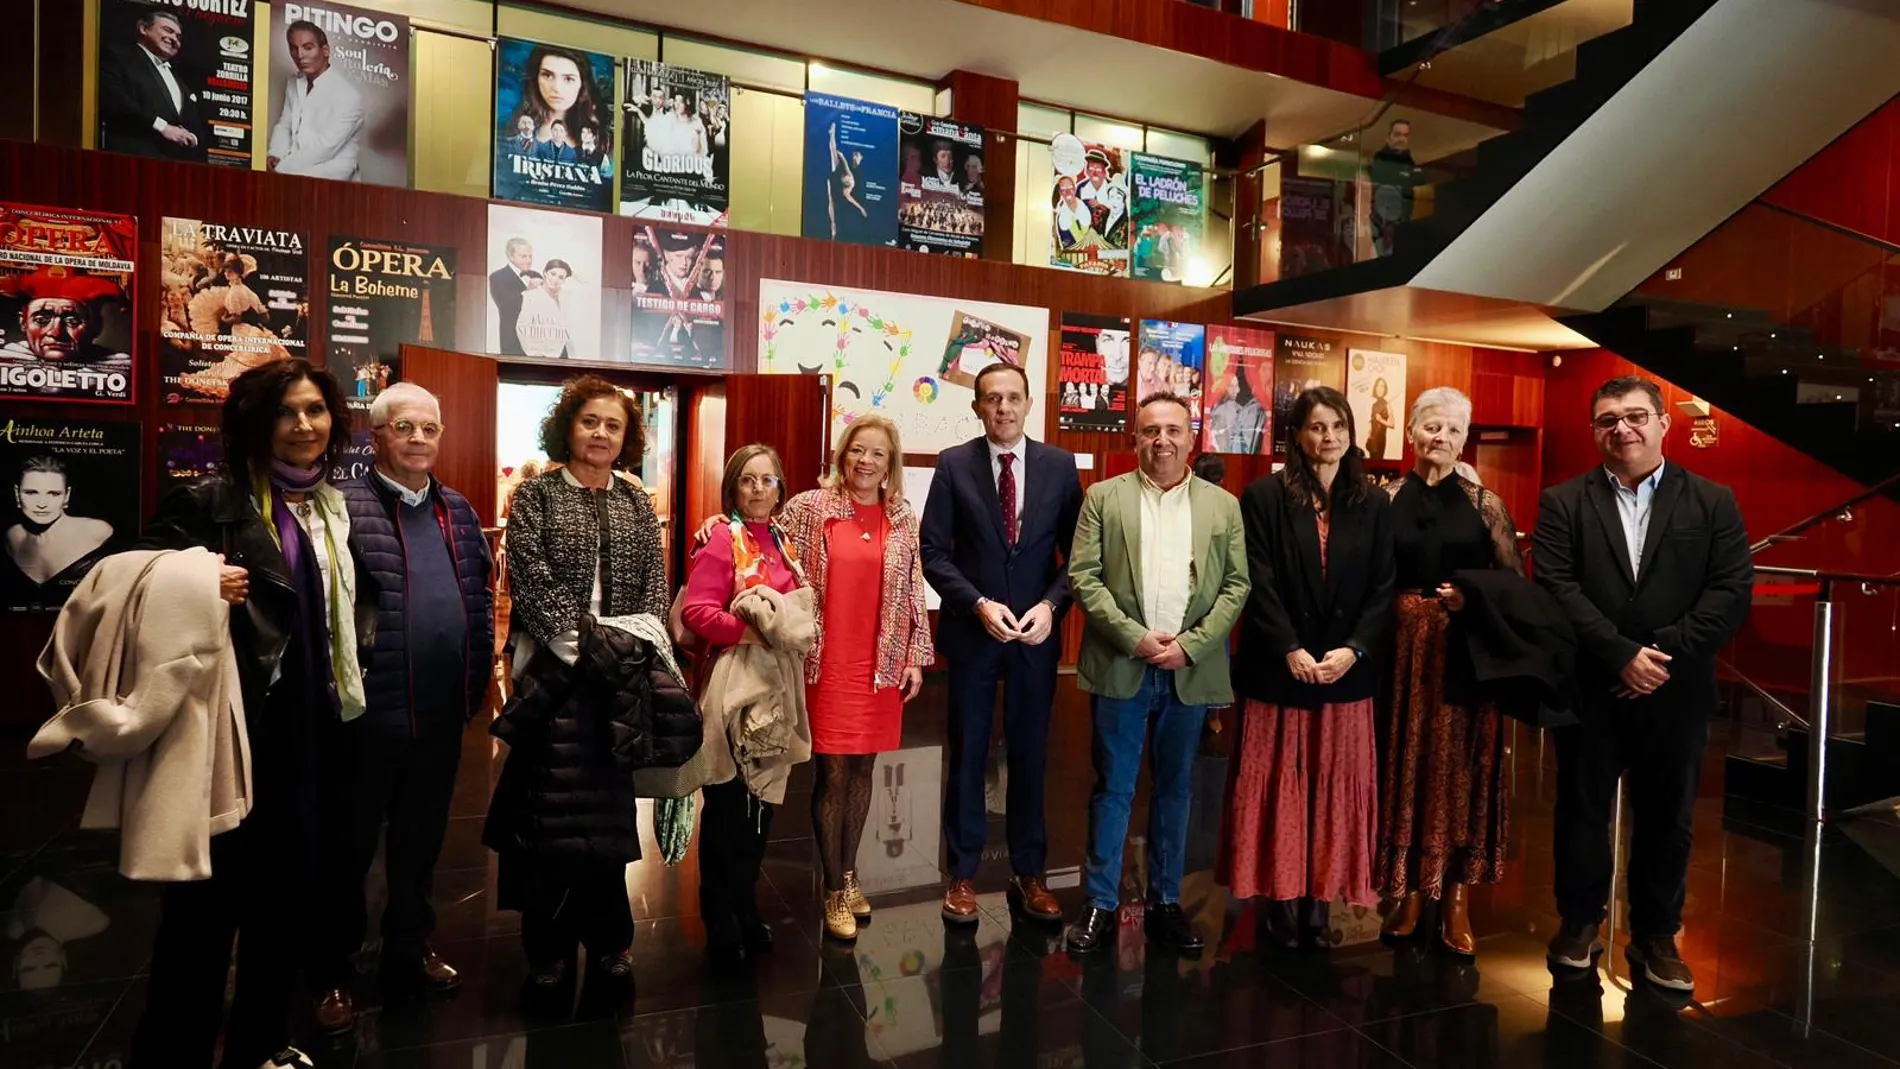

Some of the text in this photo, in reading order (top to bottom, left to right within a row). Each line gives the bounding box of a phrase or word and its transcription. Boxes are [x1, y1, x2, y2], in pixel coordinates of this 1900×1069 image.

[285, 3, 399, 43] PITINGO
[216, 69, 248, 82] ZORRILLA
[223, 62, 248, 74] TEATRO
[508, 153, 602, 185] TRISTANA
[642, 146, 715, 181] GLORIOUS
[653, 173, 688, 185] CANTANTE
[1135, 173, 1187, 192] EL LADRÓN
[1139, 186, 1198, 206] DE PELUCHES
[172, 222, 303, 249] LA TRAVIATA
[9, 252, 42, 262] NACIONAL
[44, 256, 53, 264] DE
[54, 257, 63, 265] LA
[65, 258, 86, 267] OPERA
[88, 261, 96, 269] DE
[98, 261, 132, 271] MOLDAVIA
[333, 242, 453, 280] ÓPERA
[330, 274, 419, 299] La Boheme
[636, 296, 721, 314] TESTIGO DE CARGO
[201, 343, 213, 351] DE
[206, 333, 216, 342] DE
[244, 335, 306, 348] INTERNACIONAL
[1061, 350, 1106, 368] TRAMPA
[0, 365, 126, 392] IGOLETTO
[1060, 366, 1109, 385] MORTAL
[0, 419, 104, 444] Ainhoa Arteta
